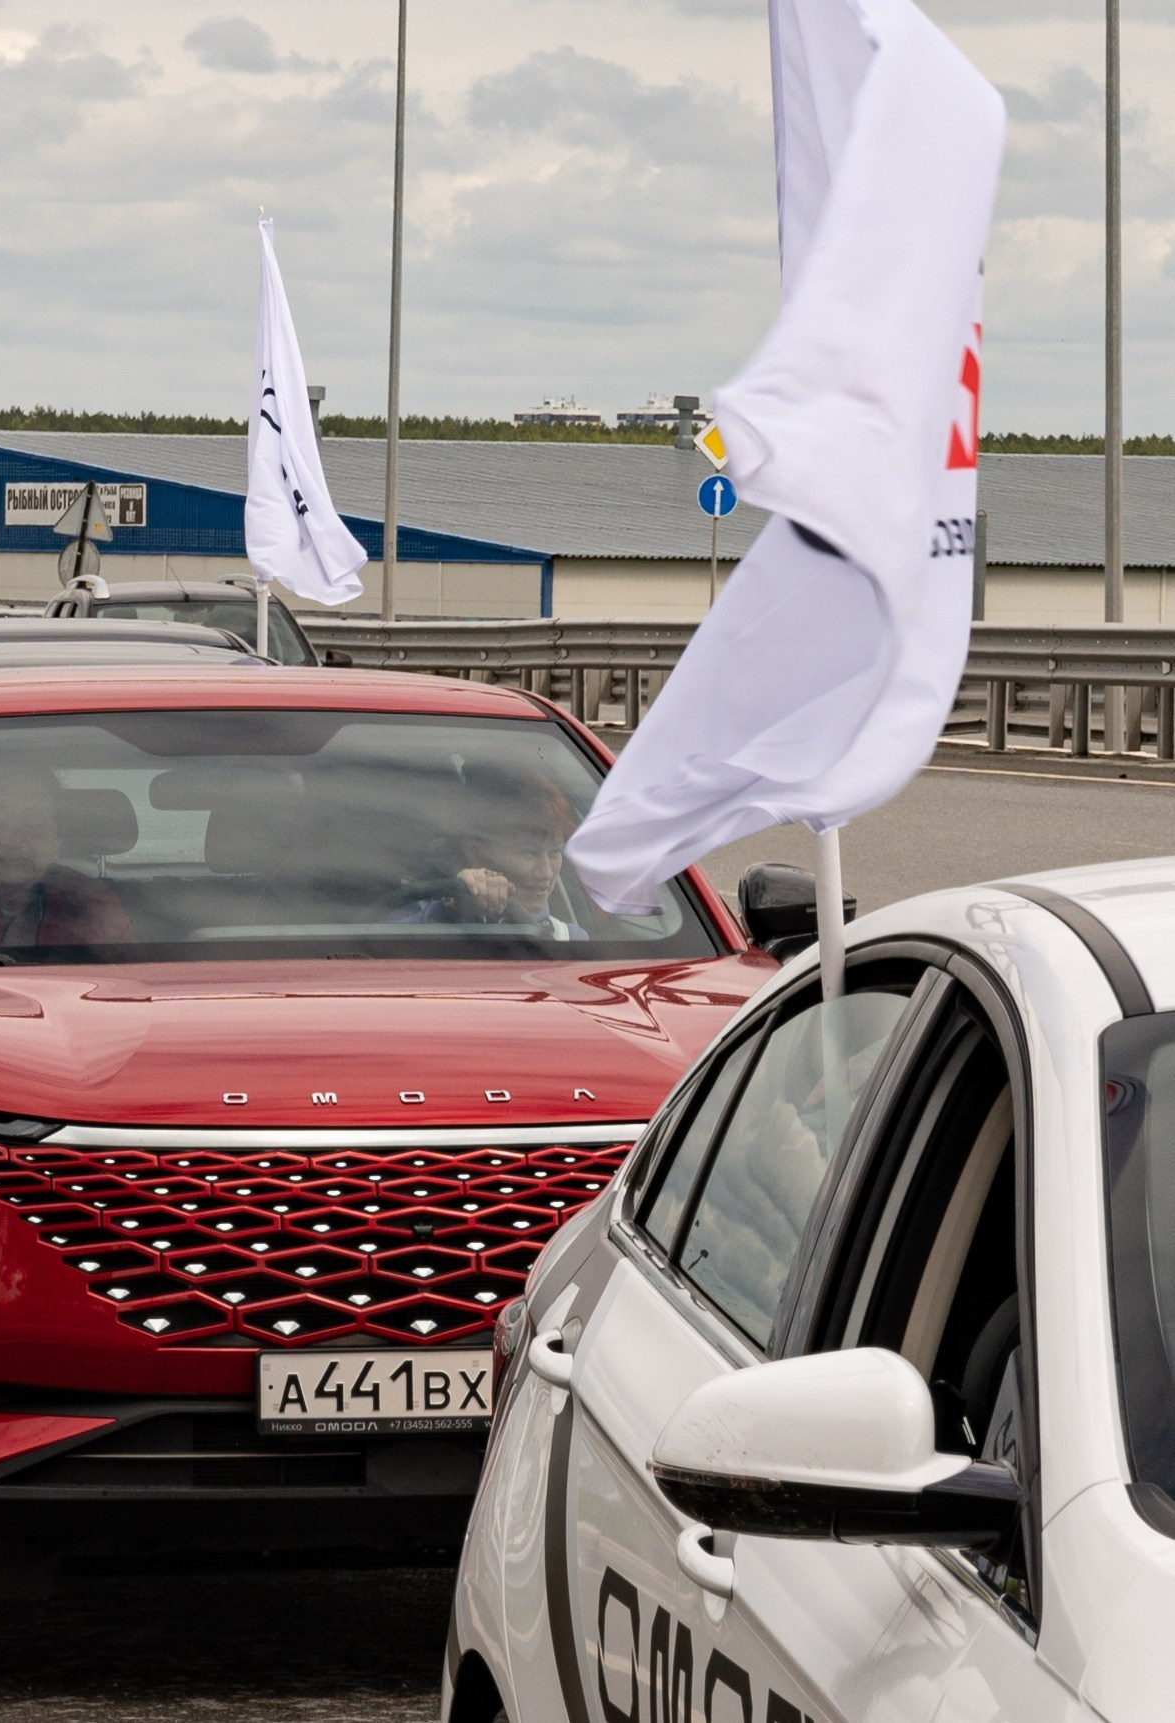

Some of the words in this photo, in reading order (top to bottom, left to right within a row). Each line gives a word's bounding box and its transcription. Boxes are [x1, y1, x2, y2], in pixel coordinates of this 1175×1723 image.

[7, 486, 48, 510] РЫБНЫЙ
[271, 1421, 303, 1432] Никко
[315, 1421, 379, 1432] OMODA
[389, 1420, 402, 1430] +7
[403, 1420, 434, 1431] (3452)
[435, 1418, 473, 1430] 562-555
